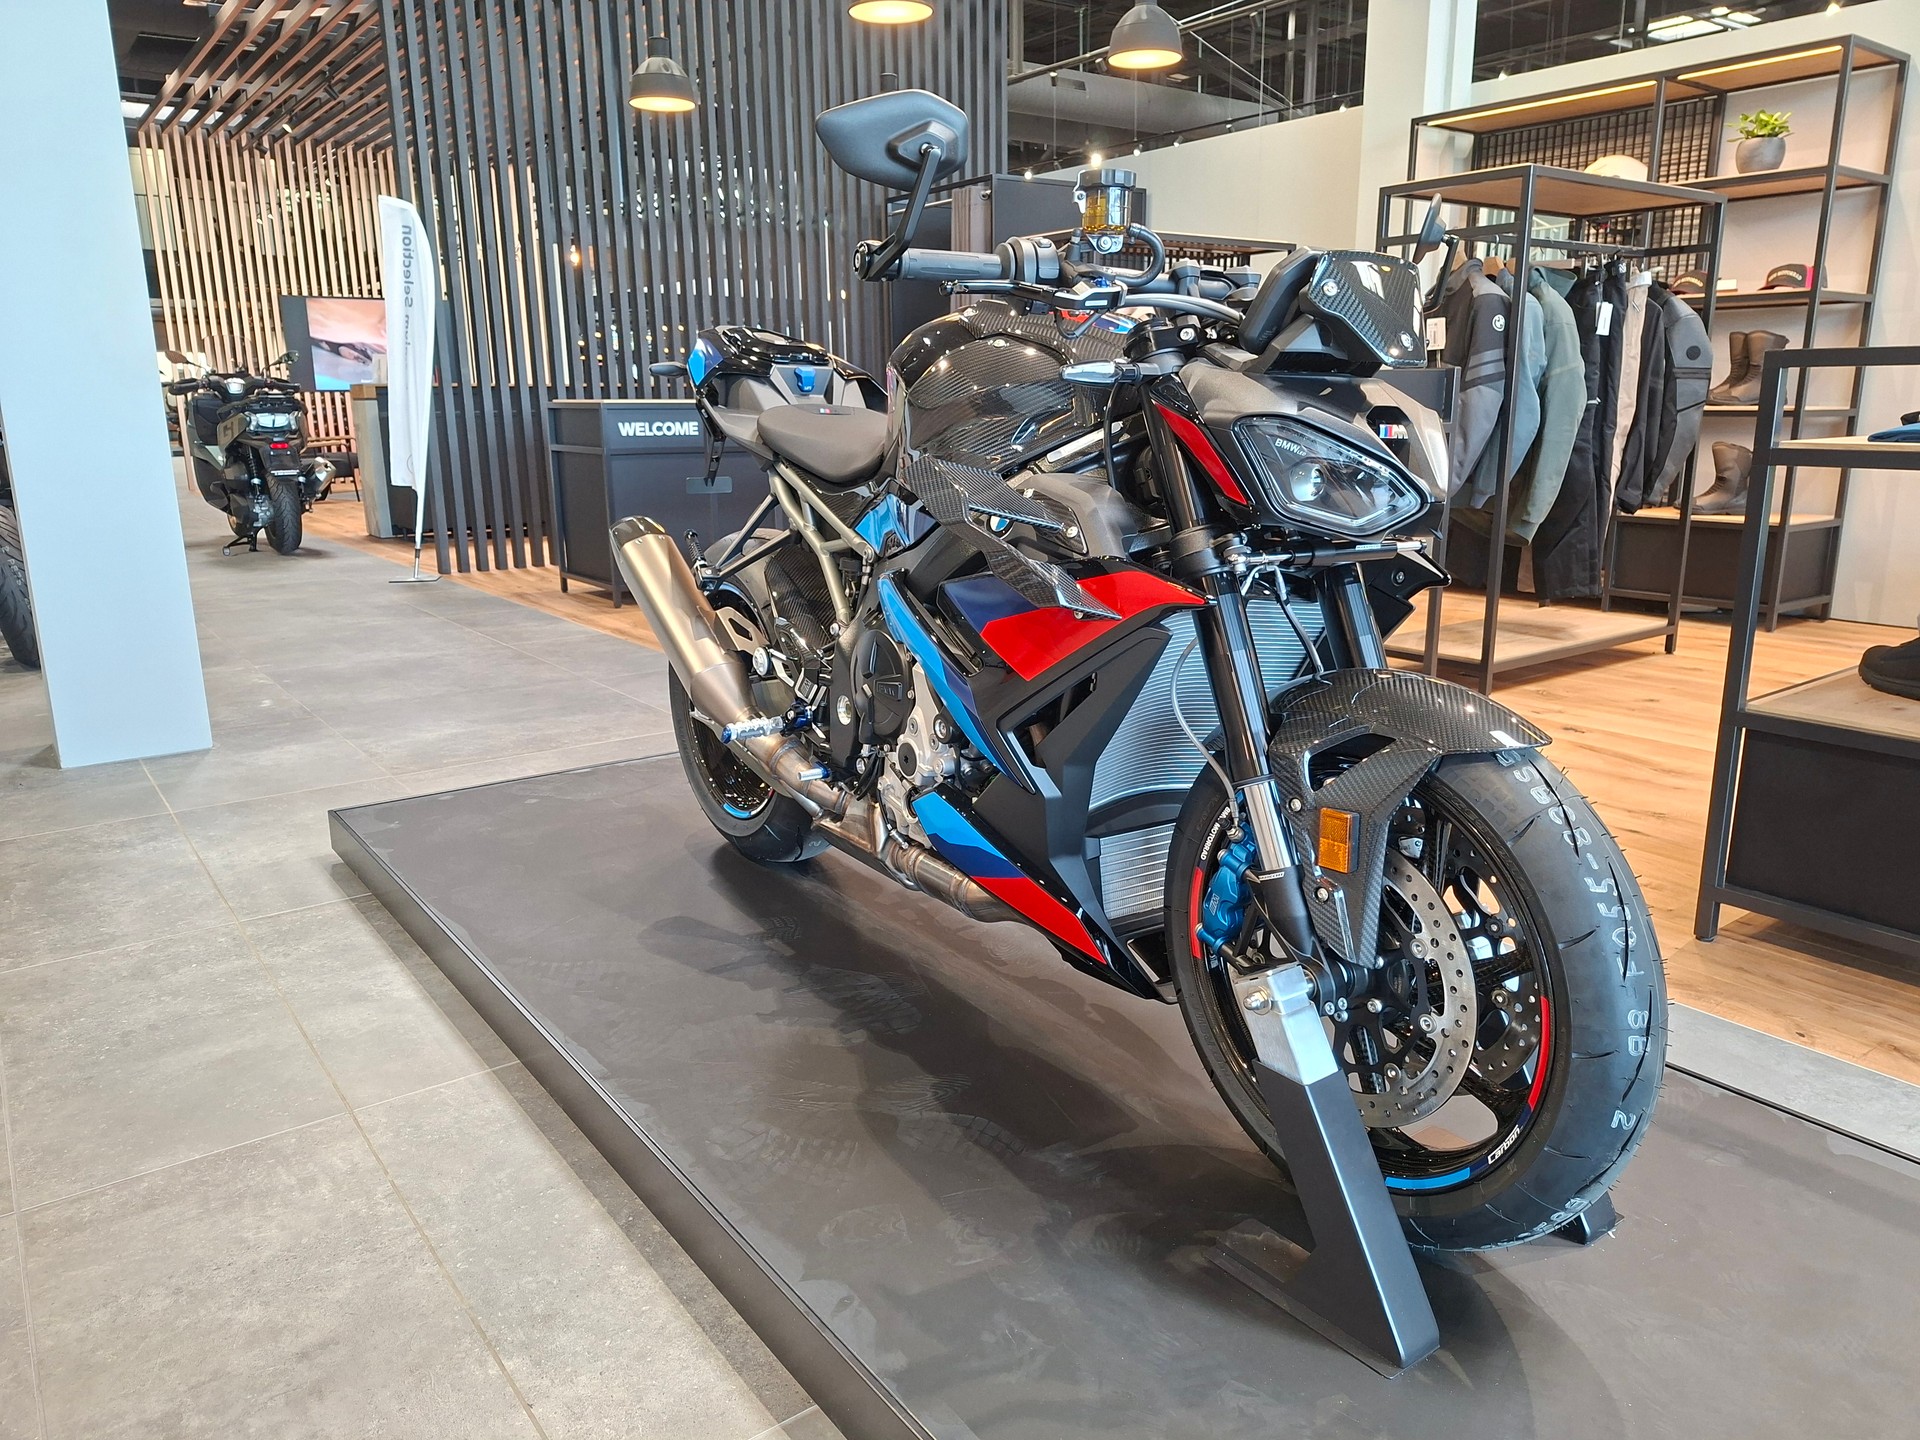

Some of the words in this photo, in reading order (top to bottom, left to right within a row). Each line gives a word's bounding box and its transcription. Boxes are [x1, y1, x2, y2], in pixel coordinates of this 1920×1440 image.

[617, 421, 699, 437] WELCOME
[1274, 438, 1300, 454] BMW
[1201, 823, 1220, 860] MOTORRAD
[1487, 1124, 1521, 1165] Carbon
